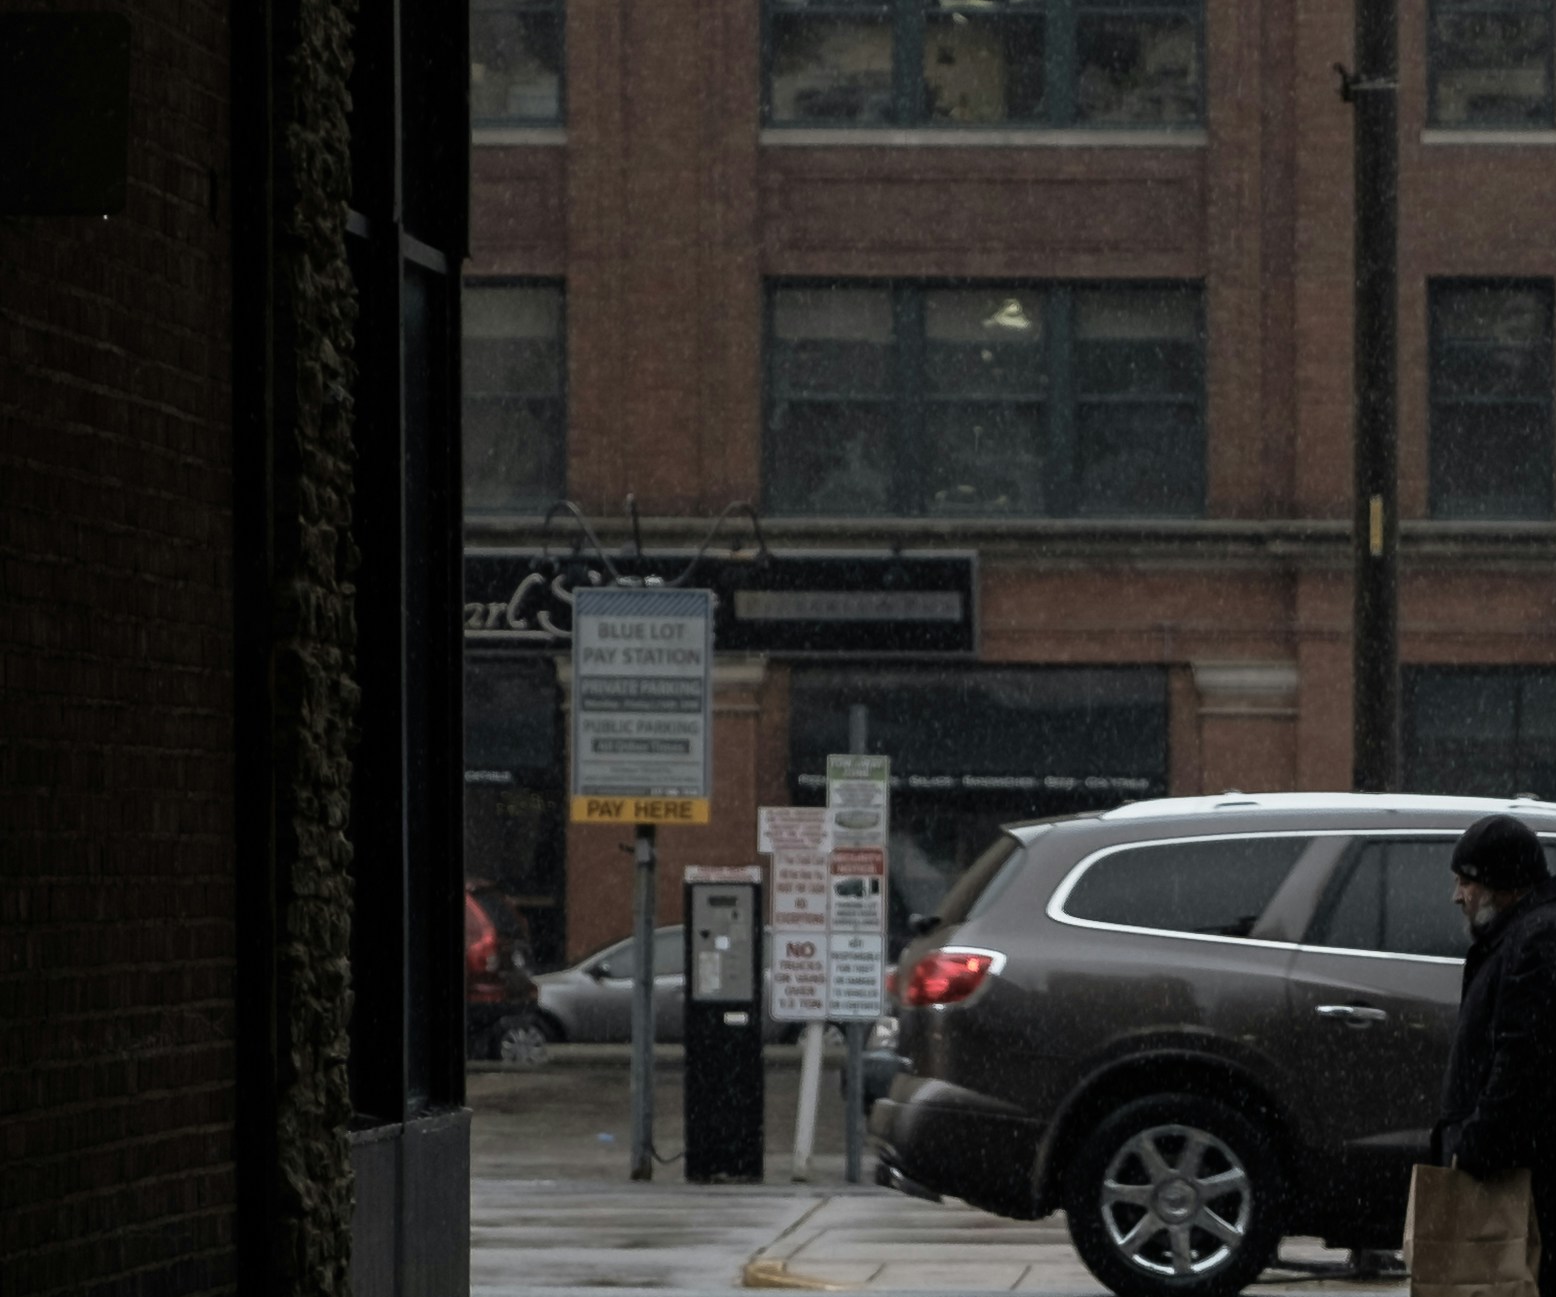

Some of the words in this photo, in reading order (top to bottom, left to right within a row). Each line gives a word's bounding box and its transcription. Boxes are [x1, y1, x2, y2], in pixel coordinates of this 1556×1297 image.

[598, 622, 644, 639] BLUE
[651, 622, 685, 639] LOT
[584, 647, 616, 664] PAY
[622, 647, 700, 664] STATION
[641, 679, 700, 696] PARKING
[583, 719, 633, 733] PUBLIC
[637, 719, 699, 733] PARKING
[587, 799, 624, 818] PAY
[634, 800, 693, 819] HERE
[786, 940, 816, 958] NO
